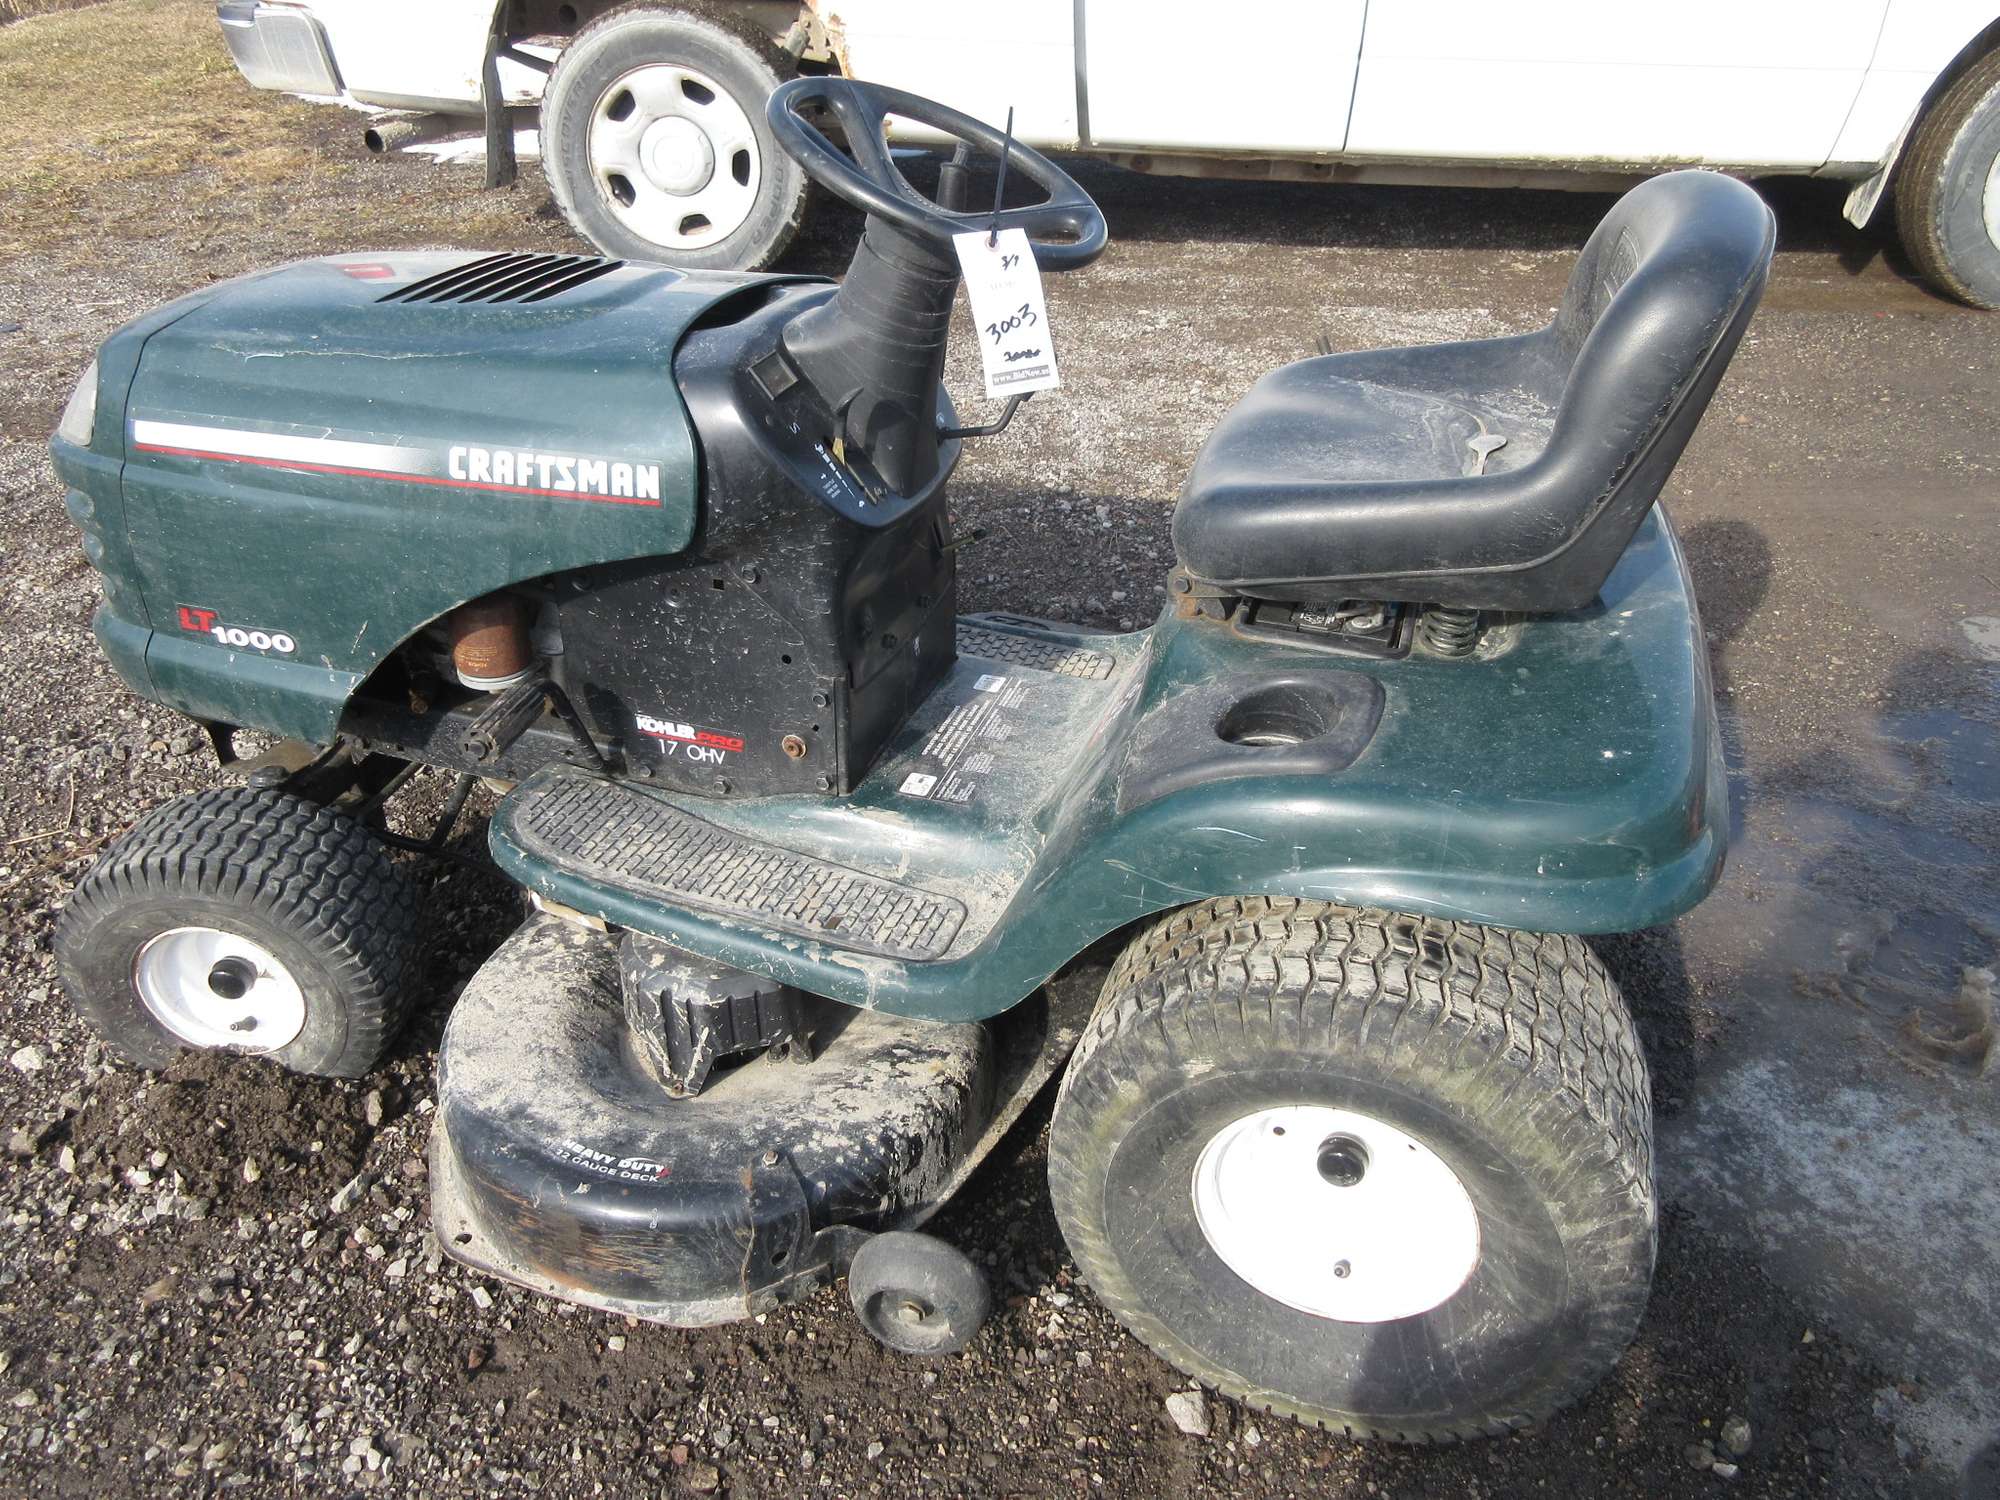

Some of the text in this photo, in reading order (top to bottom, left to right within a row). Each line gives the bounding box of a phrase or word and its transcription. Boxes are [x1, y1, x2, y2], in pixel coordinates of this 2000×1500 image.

[985, 303, 1037, 345] 3003
[449, 446, 660, 499] CRAFTSMAN
[179, 607, 216, 632] LT
[211, 626, 295, 653] 1000
[636, 717, 744, 748] KOHLER PRO
[659, 739, 725, 764] 17 OHV
[562, 1139, 665, 1174] HEAVY DUTY
[571, 1157, 616, 1176] GAUGE
[620, 1170, 660, 1182] DECK
